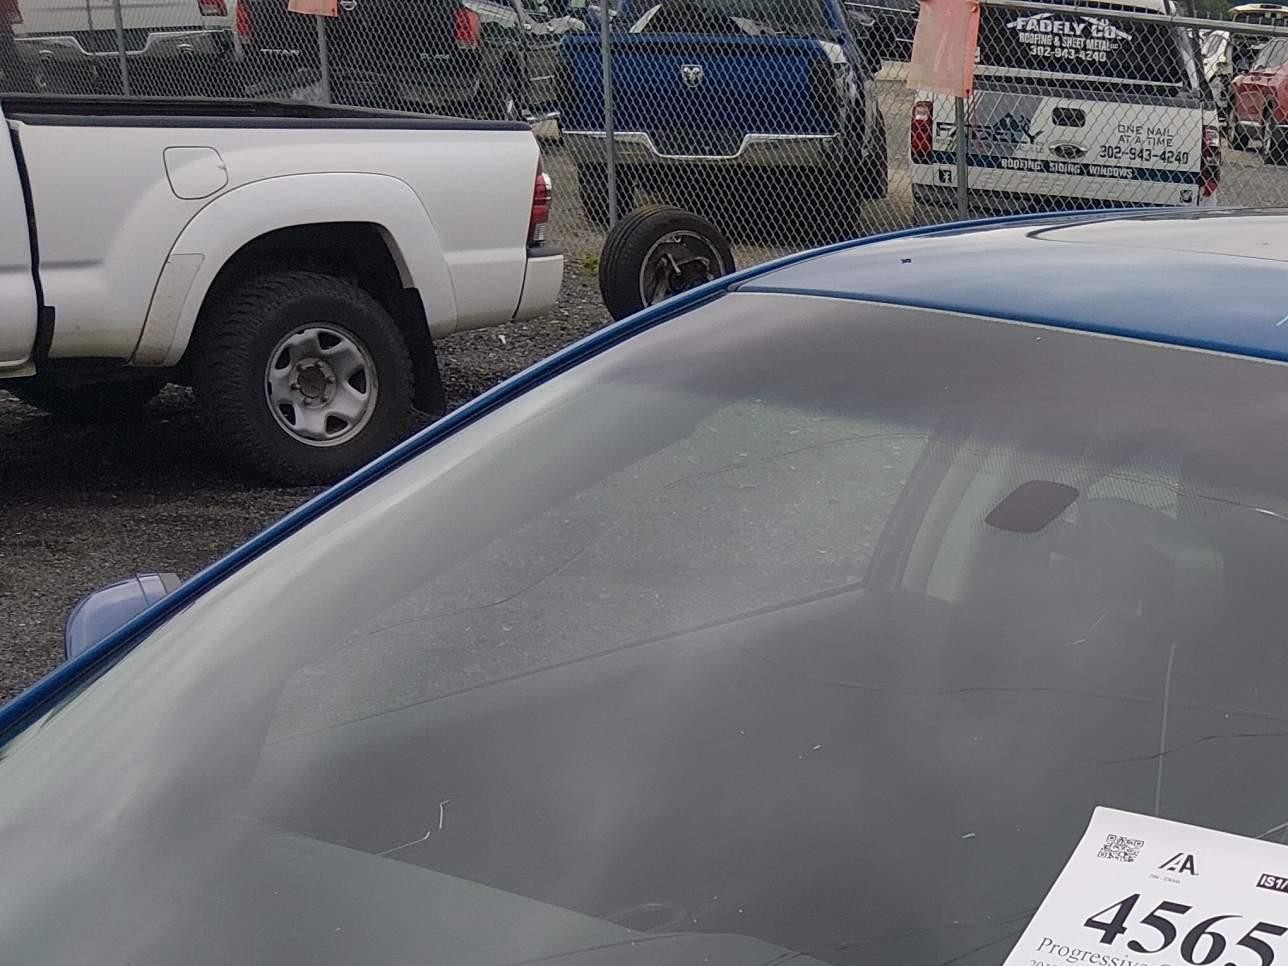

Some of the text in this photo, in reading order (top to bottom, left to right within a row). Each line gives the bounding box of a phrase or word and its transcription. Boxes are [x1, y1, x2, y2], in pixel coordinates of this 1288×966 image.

[1016, 17, 1087, 36] FADELY
[1019, 33, 1052, 46] ROOFING
[1053, 36, 1060, 47] &
[1062, 37, 1084, 49] SHEET
[1086, 39, 1110, 51] METAL
[1030, 45, 1107, 62] 302-943-4240
[1118, 124, 1174, 138] ONE NAIL
[1119, 135, 1130, 144] AT
[1147, 137, 1173, 147] TIME
[1100, 145, 1189, 165] 302-943-4240
[1001, 159, 1133, 178] ROOFING SIDING WINDOWS
